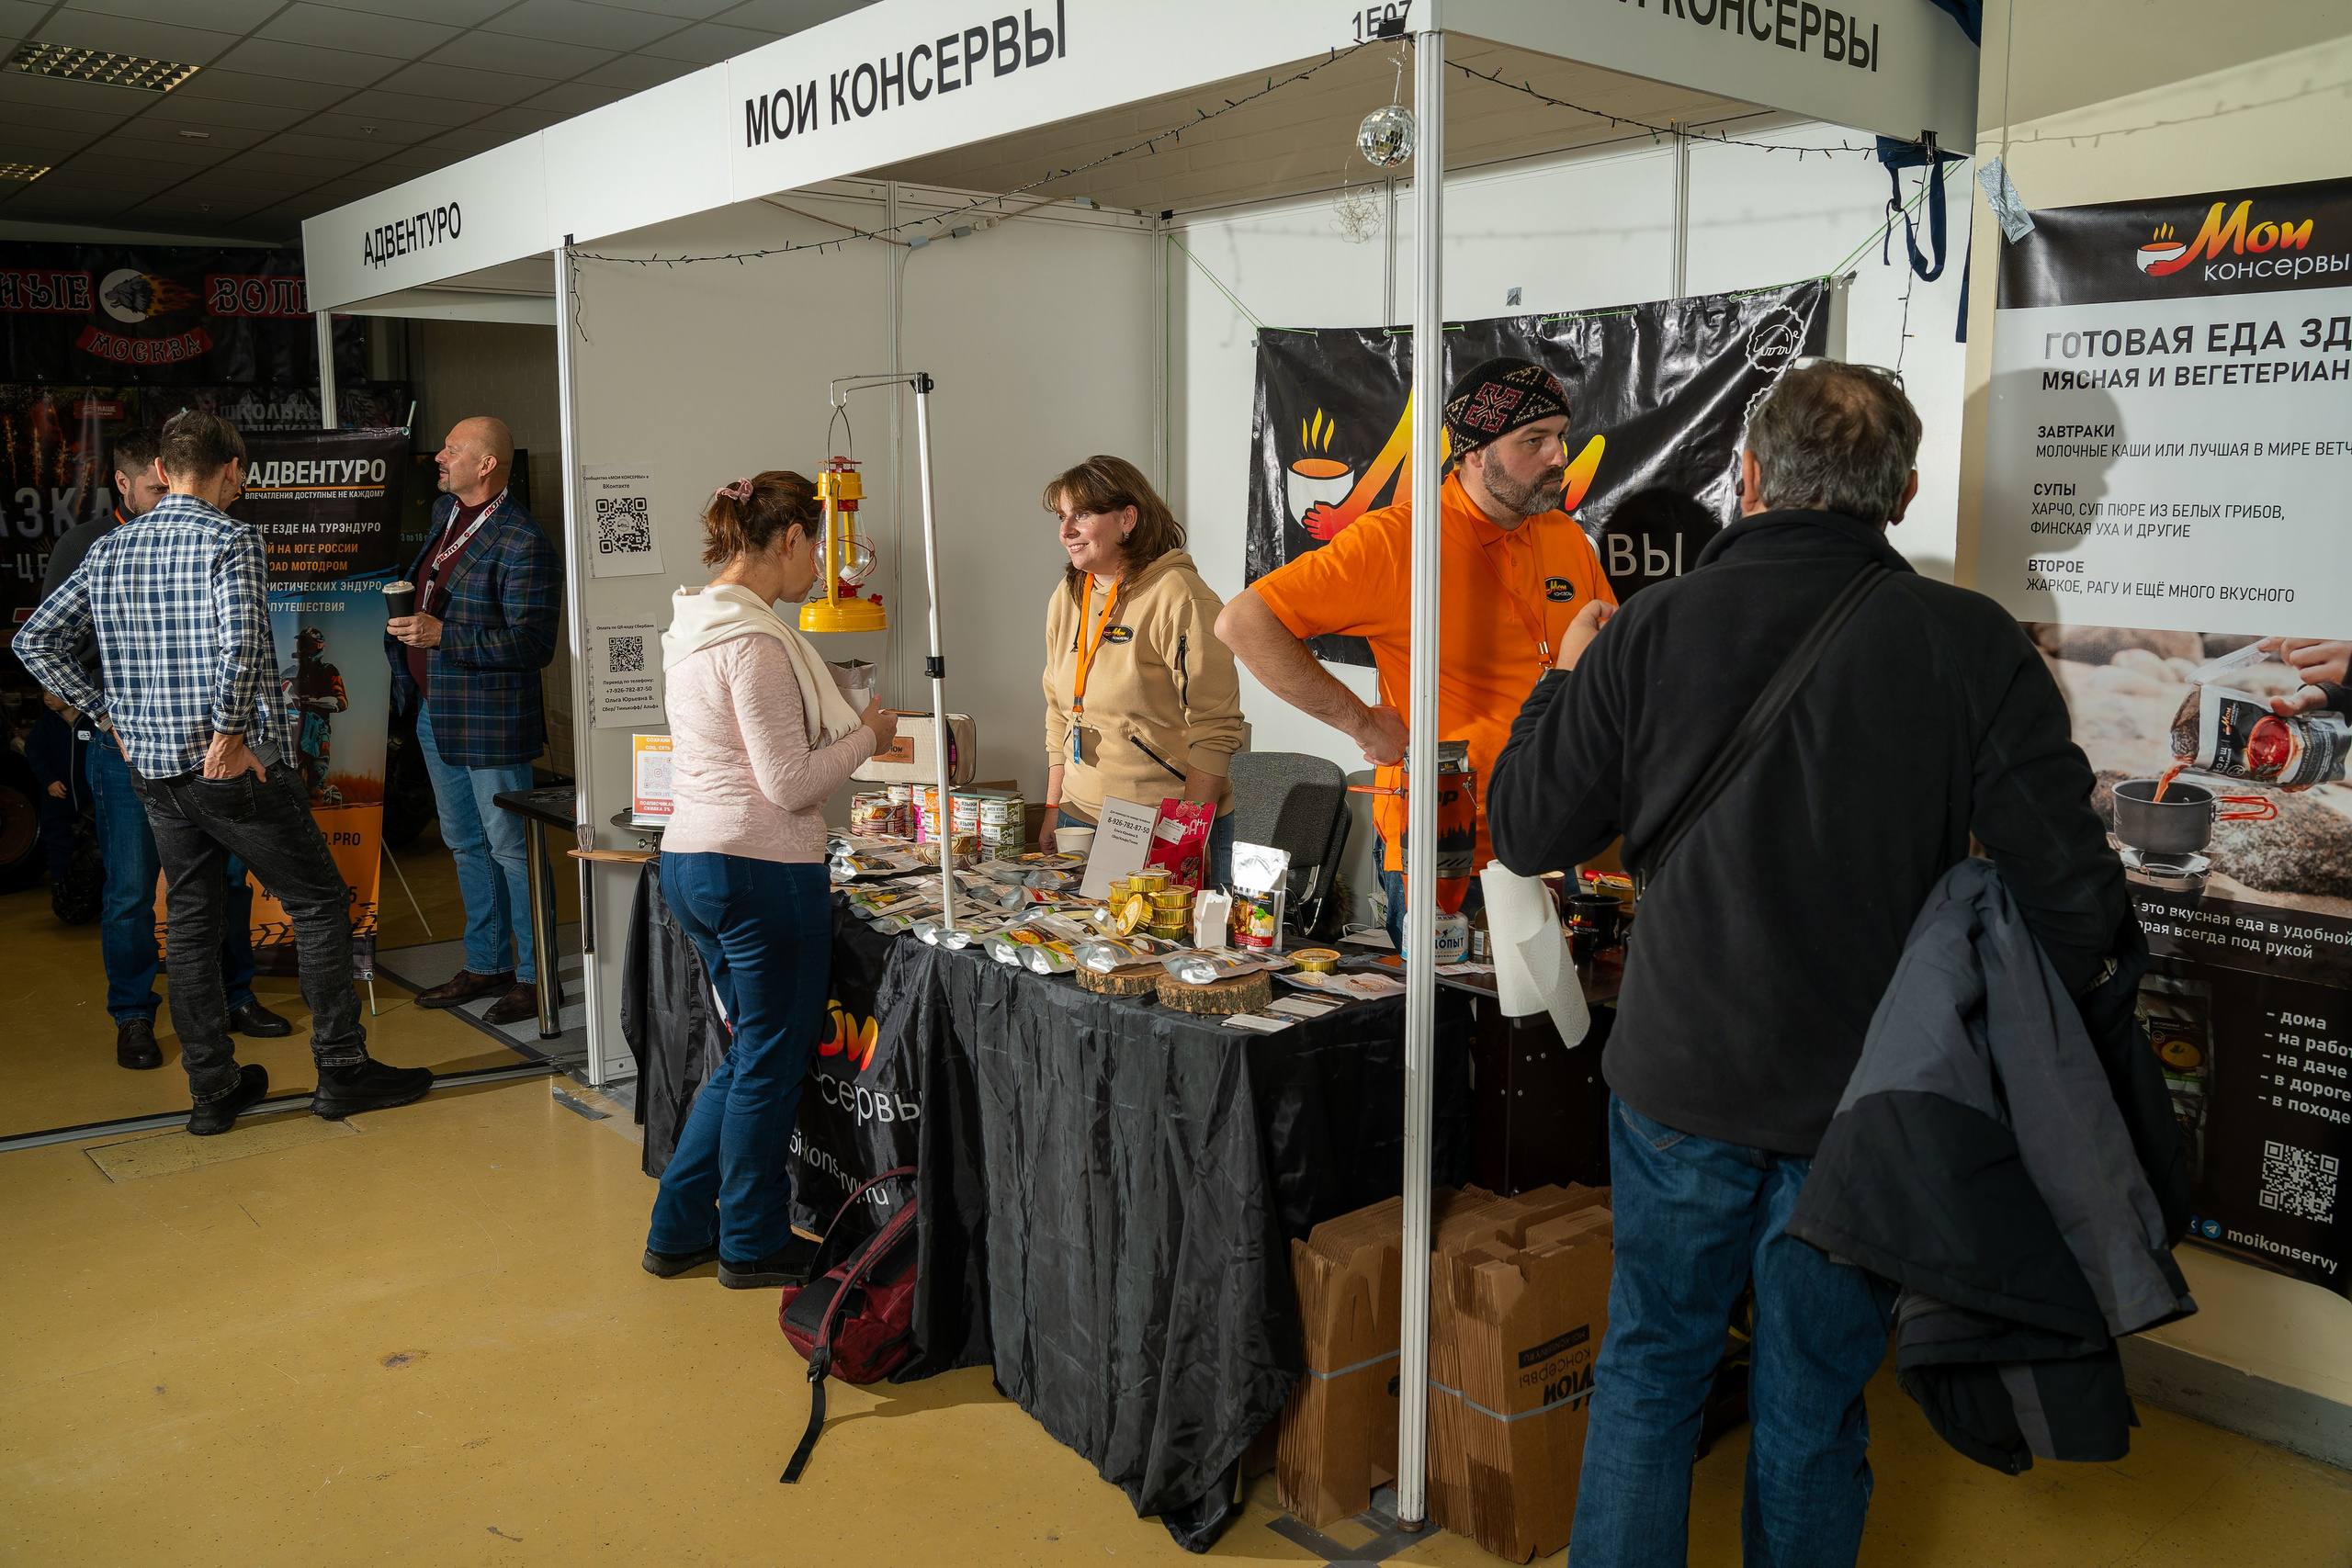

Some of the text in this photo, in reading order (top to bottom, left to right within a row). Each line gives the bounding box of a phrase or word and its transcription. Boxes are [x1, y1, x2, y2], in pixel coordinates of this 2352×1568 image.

[745, 0, 1066, 148] МОИ КОНСЕРВЫ
[364, 201, 461, 270] АДВЕНТУРО
[2200, 199, 2314, 261] Мои
[2205, 254, 2352, 282] консервы
[87, 333, 203, 364] МОСКВА
[2045, 325, 2194, 360] ГОТОВАЯ
[2208, 321, 2287, 358] ЕДА
[2042, 360, 2352, 390] МЯСНАЯ И ВЕГЕТЕРИАН
[2037, 424, 2115, 438] ЗАВТРАКИ
[2036, 444, 2109, 457] МОЛОЧНЫЕ
[2111, 444, 2151, 457] КАШИ
[2155, 444, 2185, 457] ИЛИ
[2188, 443, 2249, 457] ЛУЧШАЯ
[2254, 442, 2263, 457] В
[2268, 442, 2311, 457] МИРЕ
[246, 458, 387, 489] АДВЕНТУРО
[244, 490, 385, 501] ВПЕЧАТЛЕНИЯ ДОСТУПНЫЕ НЕ КАЖДОМУ
[2033, 483, 2076, 496] СУПЫ
[2030, 502, 2285, 521] ХАРЧО, СУП ПЮРЕ ИЗ БЕЛЫХ ГРИБОВ,
[273, 524, 299, 536] ЕЗДЕ
[302, 524, 316, 534] НА
[319, 522, 381, 535] ТУРЭНДУРО
[2030, 521, 2191, 538] ФИНСКАЯ УХА И ДРУГИЕ
[277, 543, 291, 554] НА
[294, 543, 314, 554] ЮГЕ
[317, 543, 358, 554] РОССИИ
[290, 560, 348, 573] МОТОДРОМ
[2028, 559, 2085, 573] ВТОРОЕ
[340, 581, 382, 593] ЭНДУРО
[2026, 578, 2295, 603] ЖАРКОЕ, РАГУ И ЕЩЁ МНОГО ВКУСНОГО
[1107, 816, 1150, 835] 8-926-782-87-50
[2142, 901, 2352, 945] это вкусная еда в удобной
[2174, 926, 2226, 944] всегда
[2231, 936, 2260, 952] под
[2266, 942, 2313, 959] рукой
[2280, 1011, 2327, 1031] дома
[2278, 1032, 2300, 1047] на
[2277, 1054, 2347, 1078] на даче
[2274, 1075, 2352, 1102] в дороге
[2272, 1095, 2352, 1124] в походе
[2228, 1229, 2338, 1275] moikonservy
[1520, 1347, 1590, 1388] консервы
